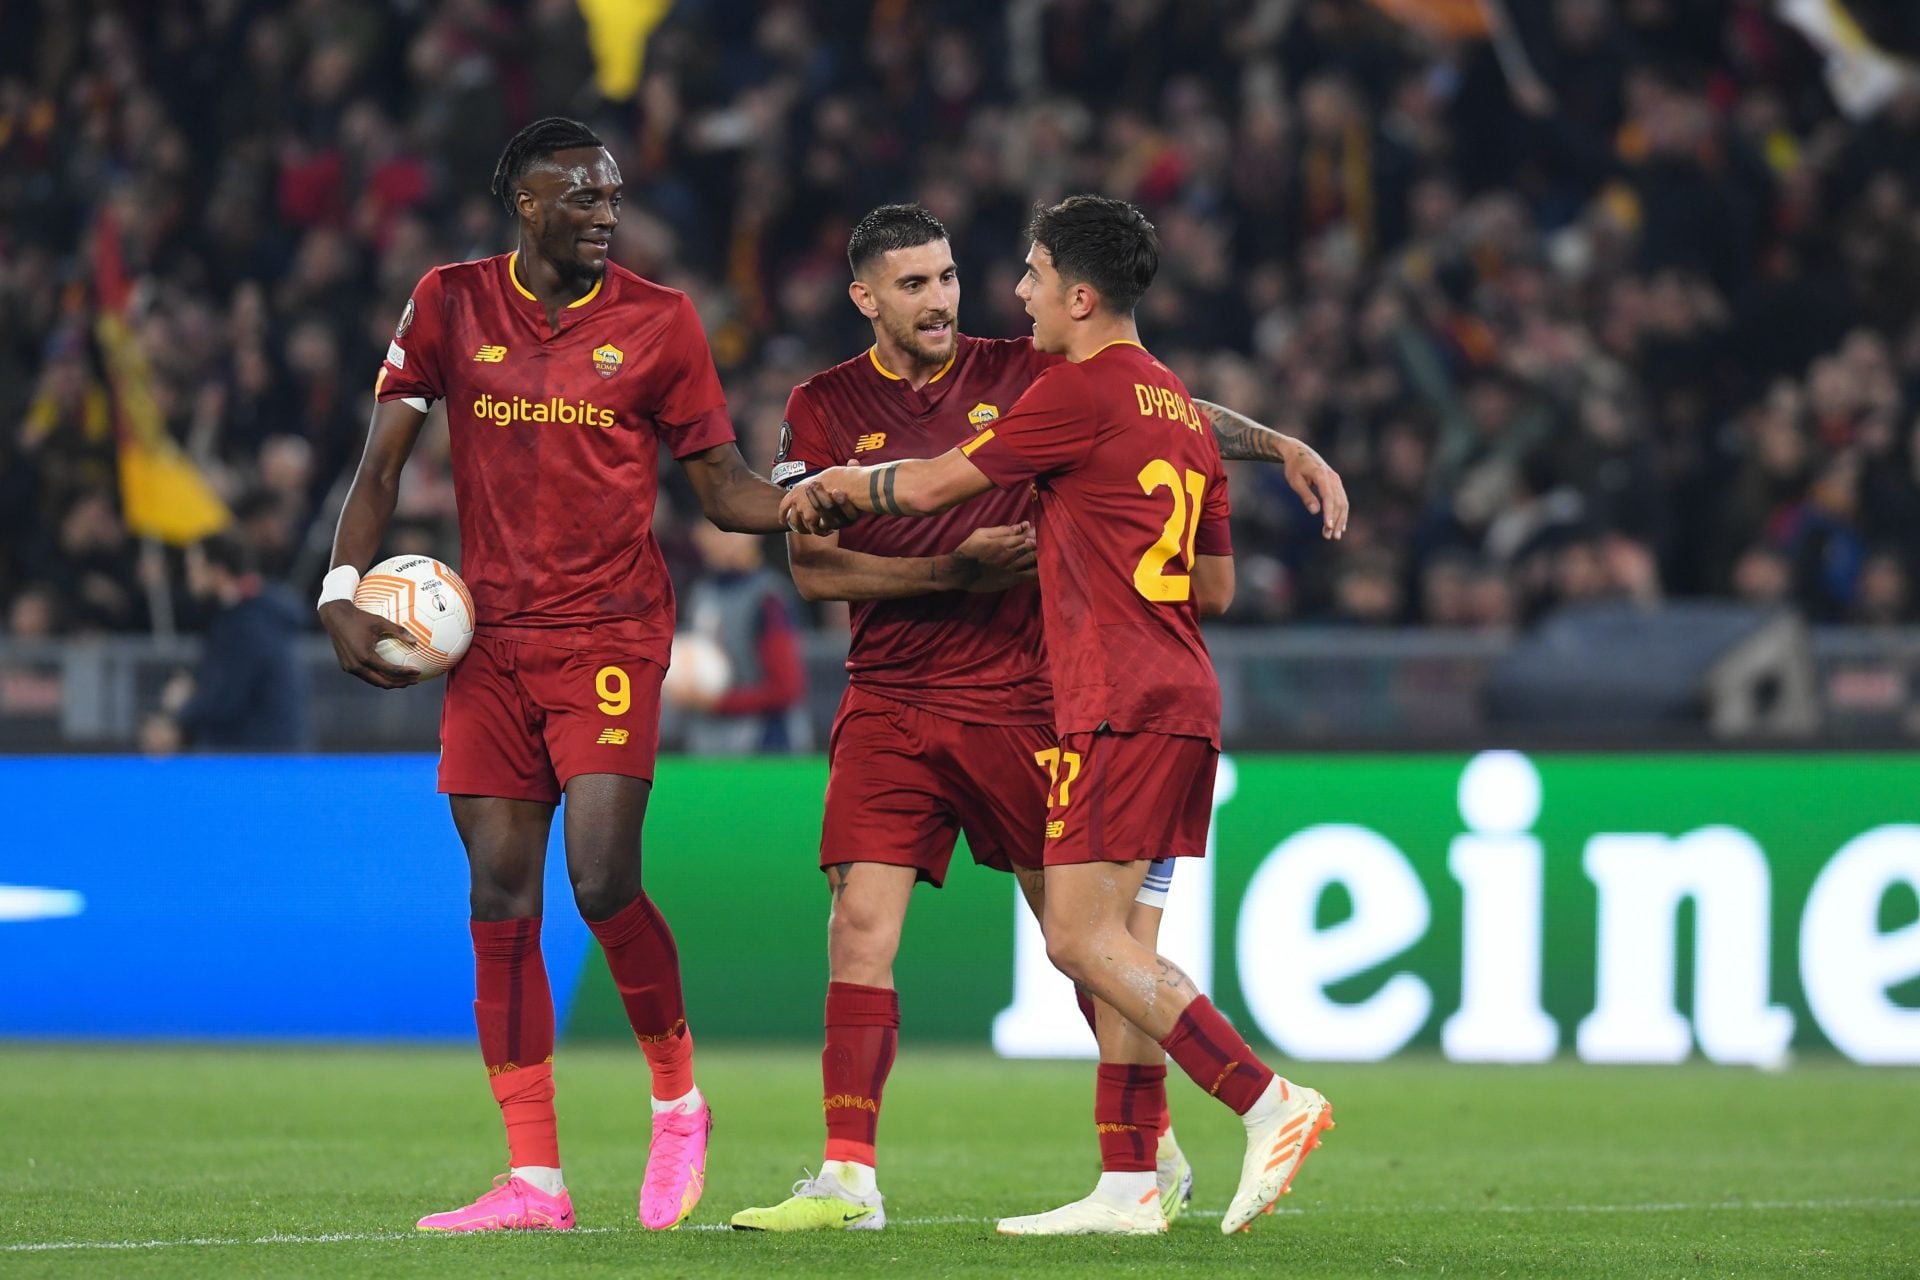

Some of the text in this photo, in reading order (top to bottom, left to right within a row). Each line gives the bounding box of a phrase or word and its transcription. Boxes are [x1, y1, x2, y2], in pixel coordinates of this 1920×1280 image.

[595, 363, 617, 372] ROMA
[473, 393, 615, 428] digitalbits
[1134, 383, 1203, 435] DYBALA
[1133, 459, 1206, 602] 21
[596, 666, 630, 716] 9
[822, 1094, 876, 1113] ROMA
